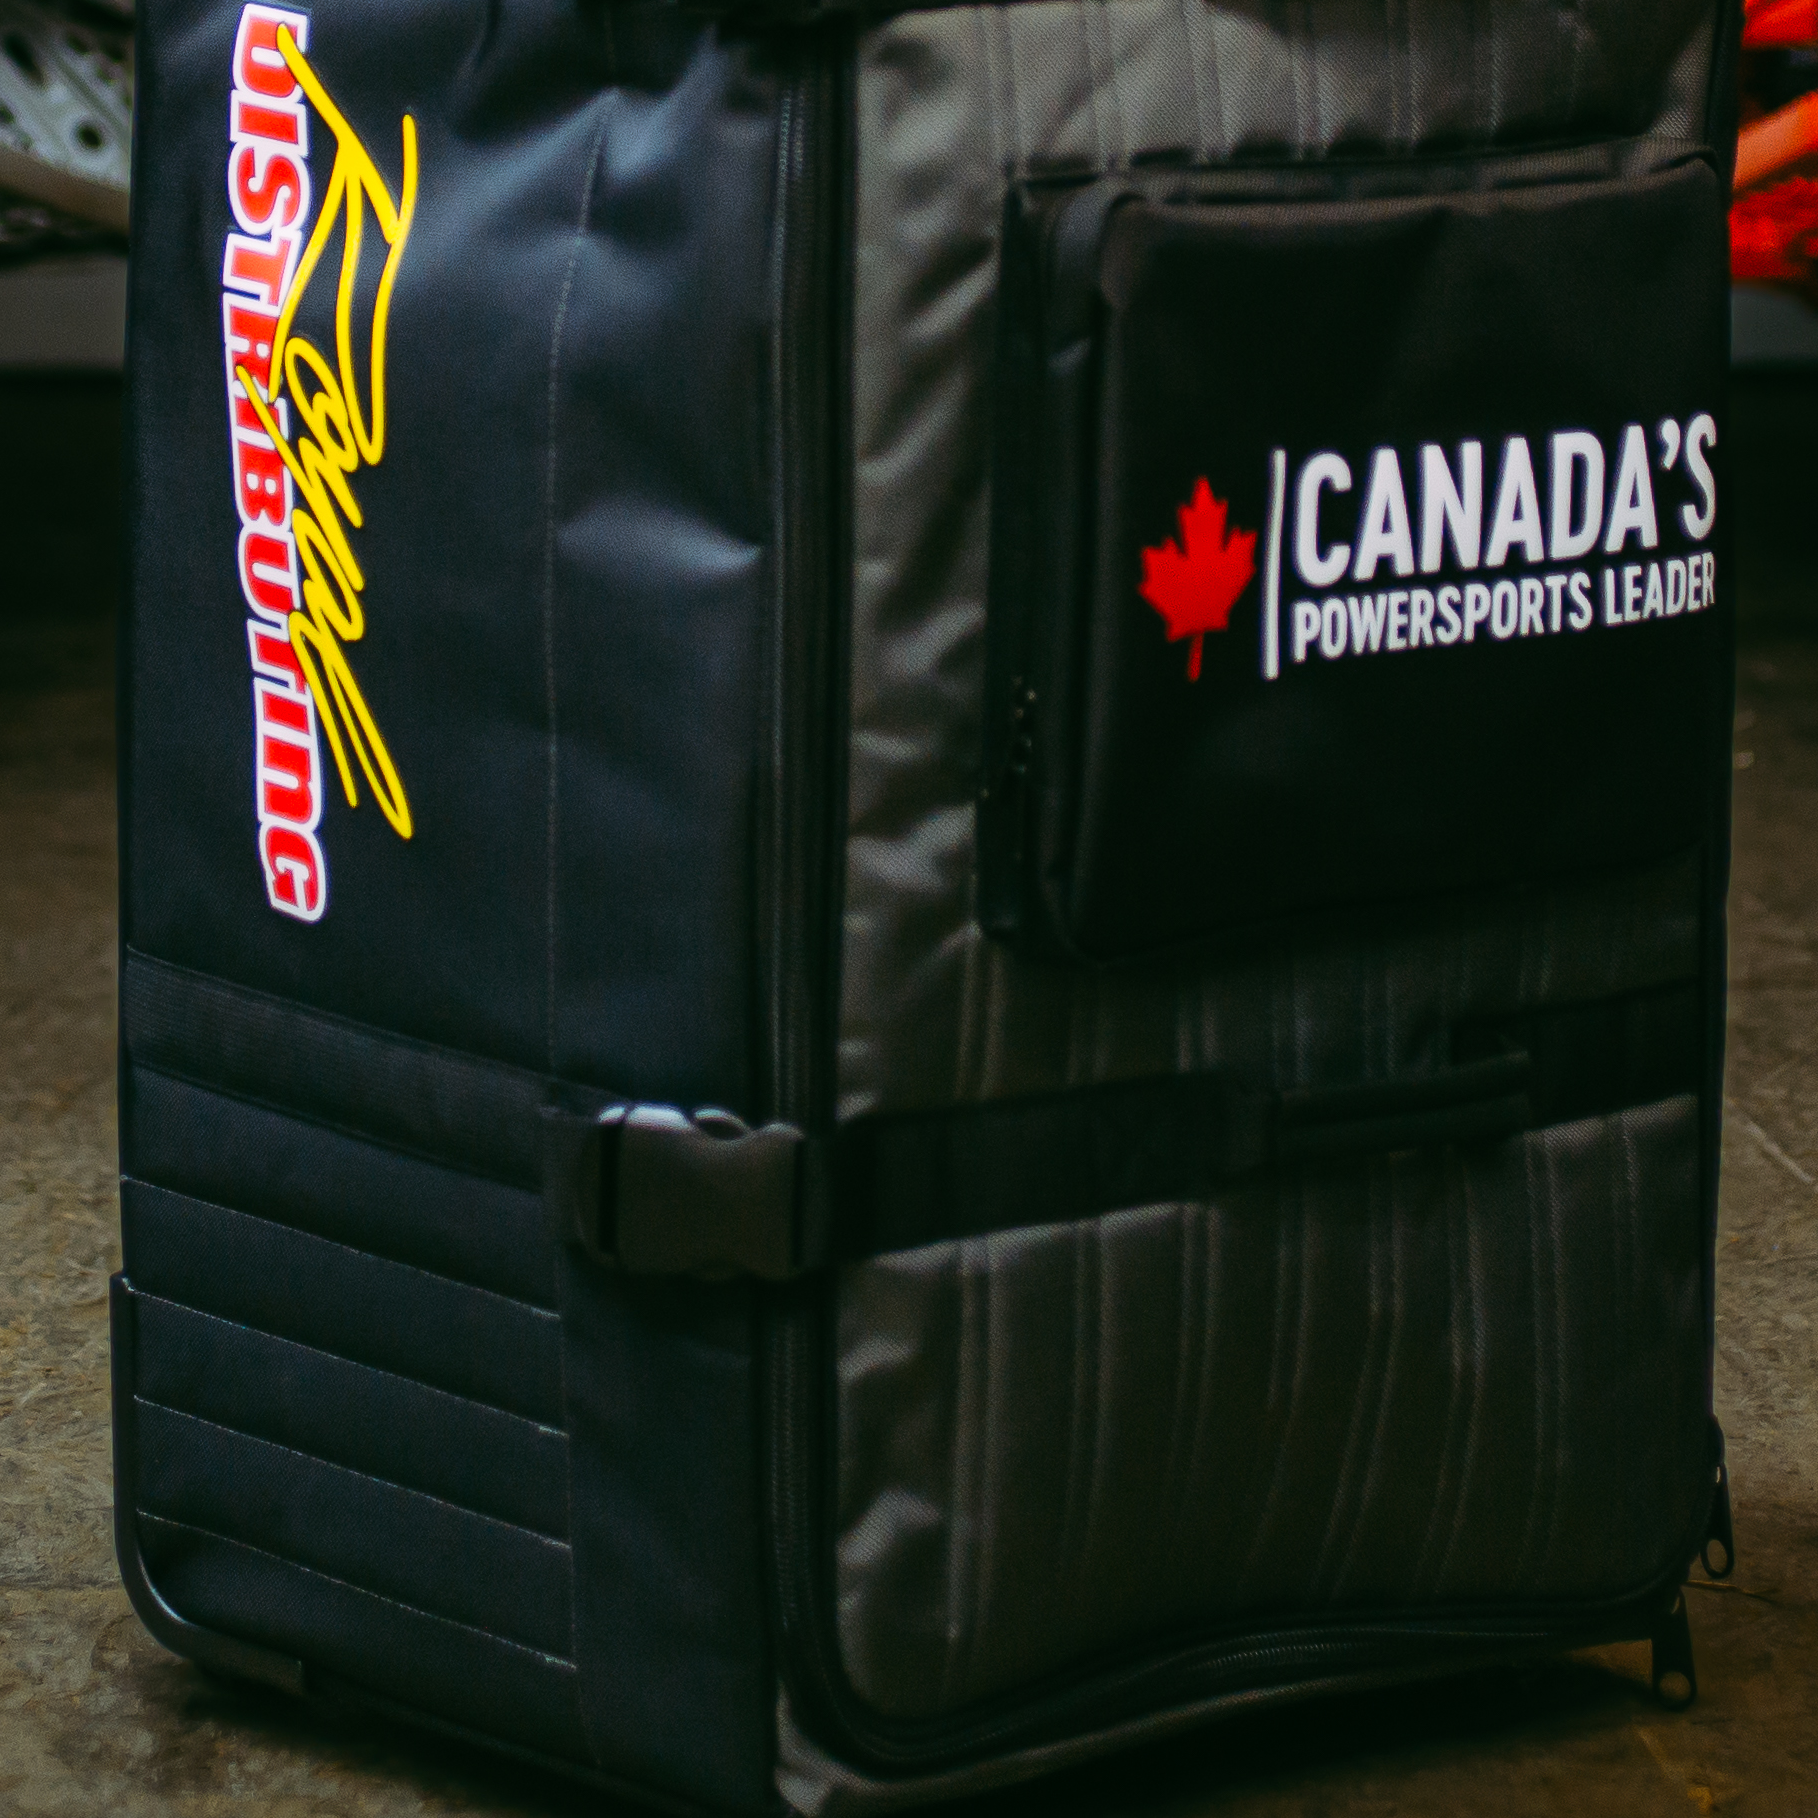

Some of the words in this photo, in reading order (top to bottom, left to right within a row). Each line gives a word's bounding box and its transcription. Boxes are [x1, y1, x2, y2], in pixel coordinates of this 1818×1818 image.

[1292, 411, 1717, 587] CANADA'S
[1292, 571, 1592, 663] POWERSPORTS
[1601, 551, 1716, 626] LEADER
